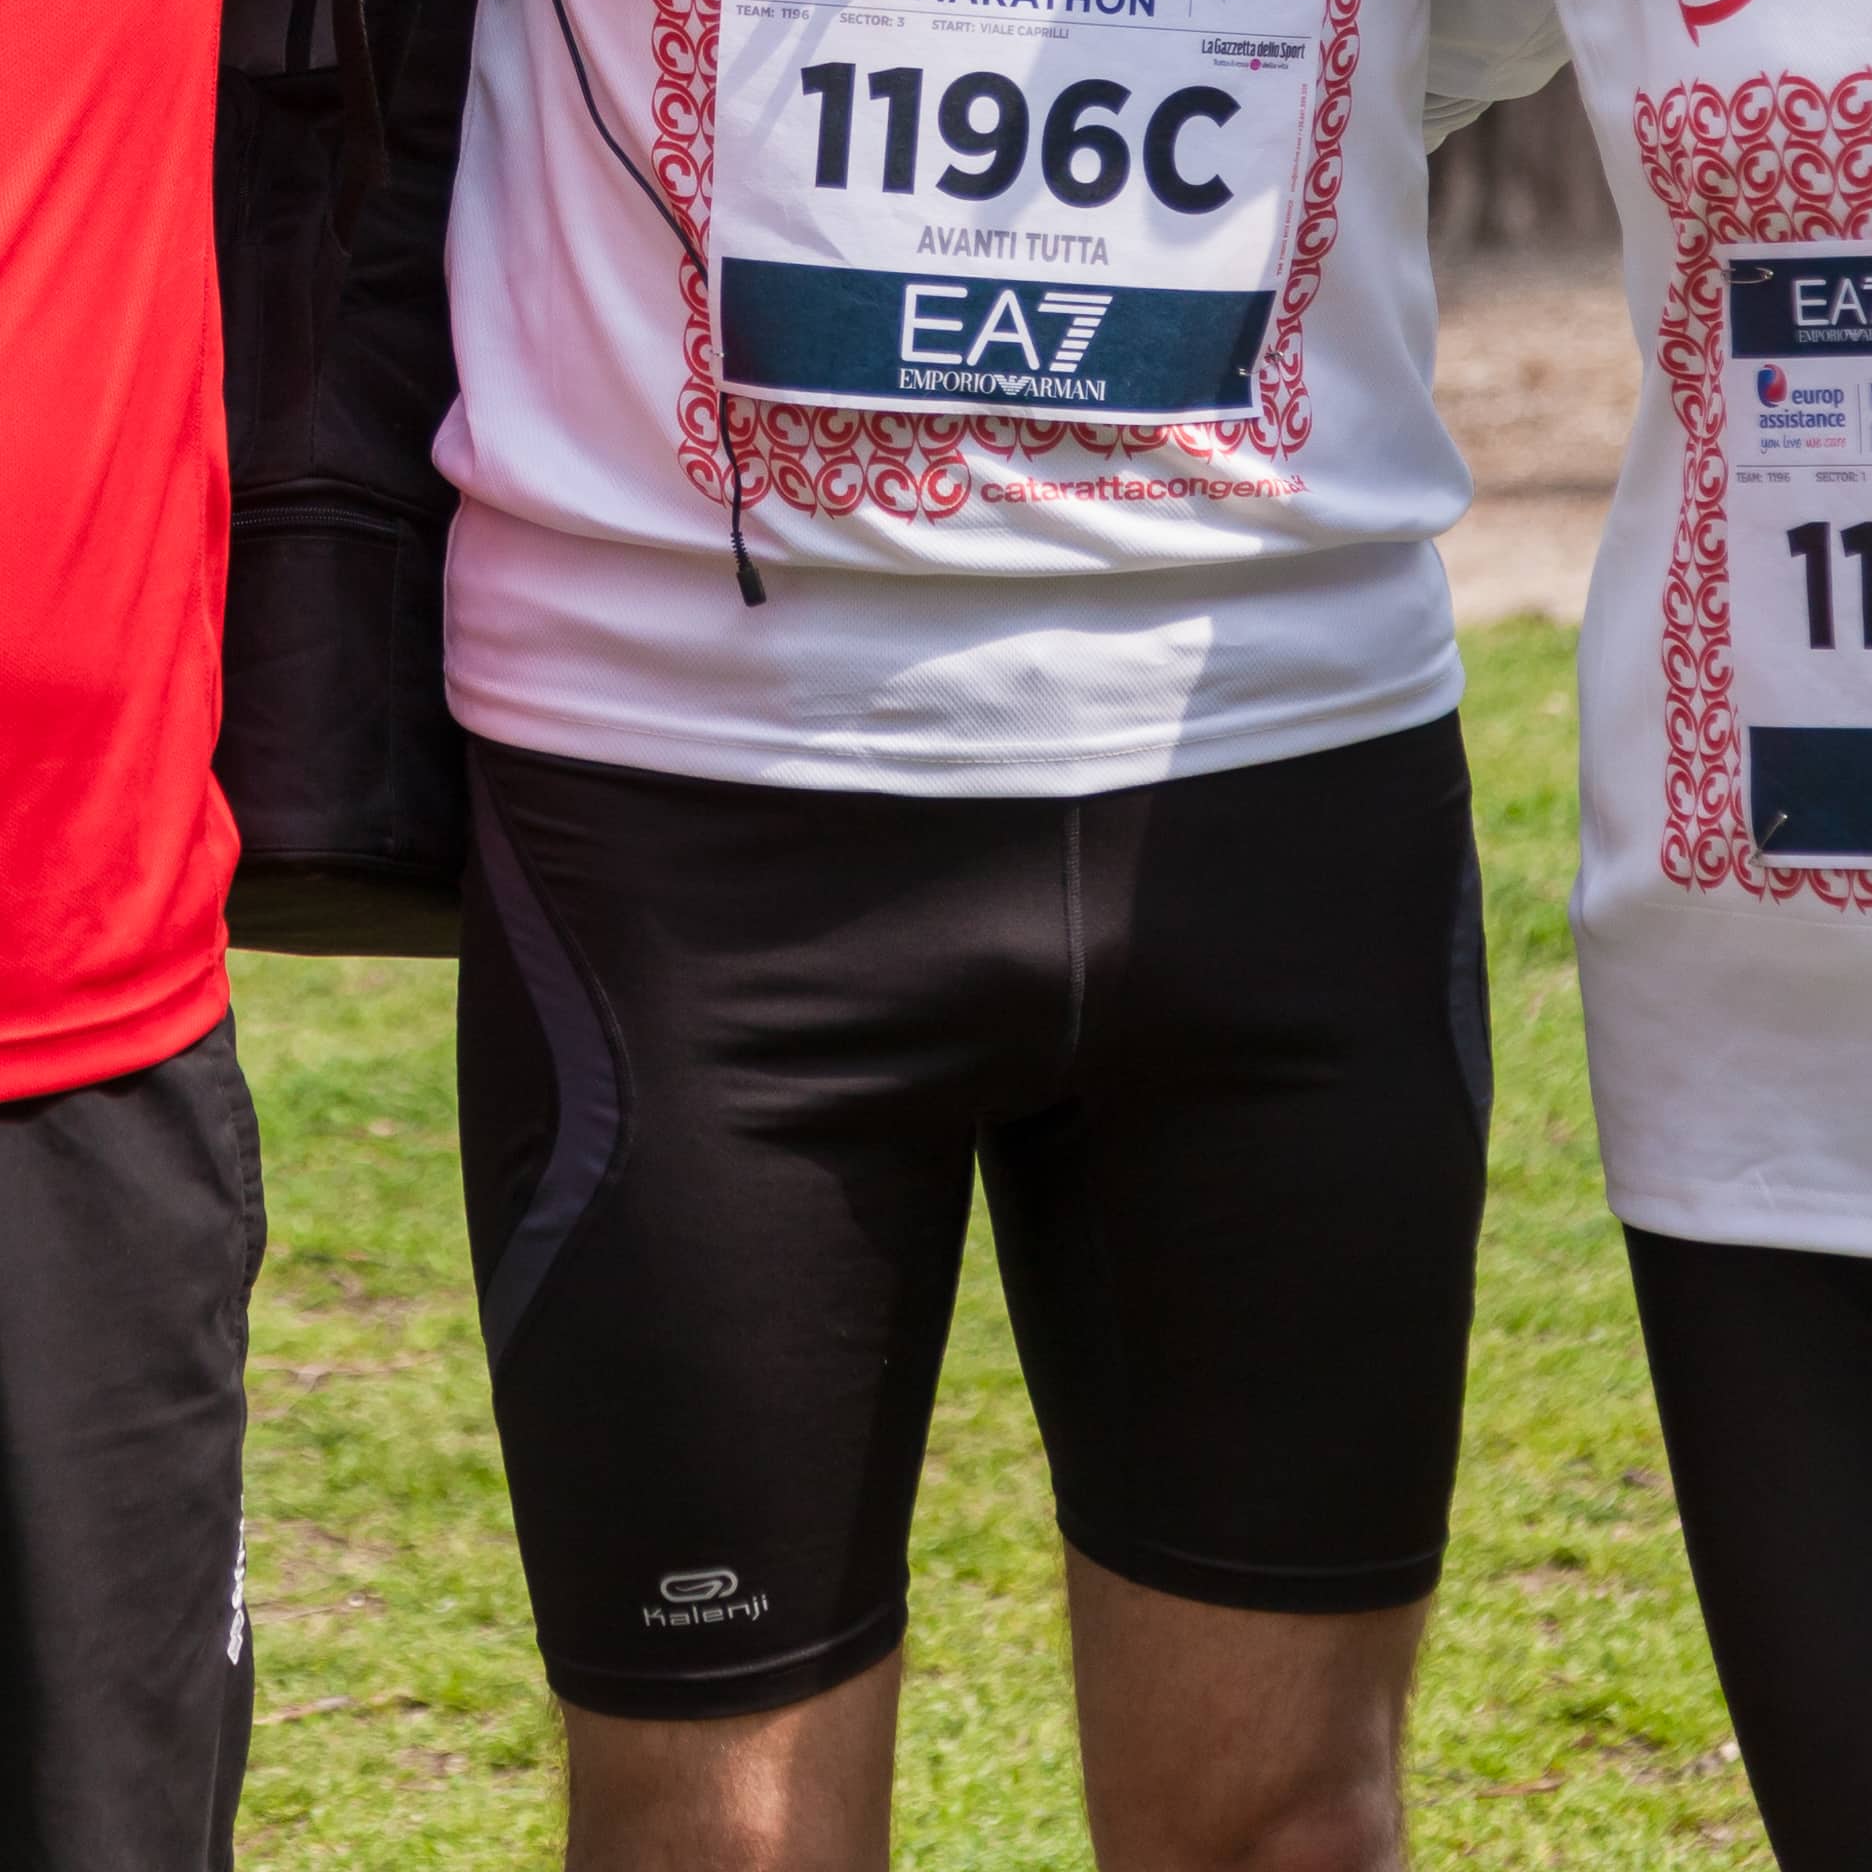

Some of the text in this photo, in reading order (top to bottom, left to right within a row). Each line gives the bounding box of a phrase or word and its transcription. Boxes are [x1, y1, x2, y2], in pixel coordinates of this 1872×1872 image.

[736, 4, 810, 20] TEAM: 1196
[839, 12, 905, 28] SECTOR: 3
[931, 18, 1069, 40] START: VIALE CAPRILLI
[1214, 38, 1256, 57] Gazzetta
[1256, 40, 1279, 58] dello
[1280, 42, 1305, 60] Sport
[799, 61, 1241, 216] 1196C
[917, 225, 1110, 266] AVANTI TUTTA
[900, 283, 1113, 373] EA7
[1798, 328, 1848, 343] EMPORIO
[899, 368, 1106, 402] EMPORIO ARMANI
[1791, 388, 1844, 406] europ
[1759, 409, 1846, 429] assistance
[1815, 471, 1859, 483] SECTOR:
[643, 1594, 768, 1627] Kalenji
